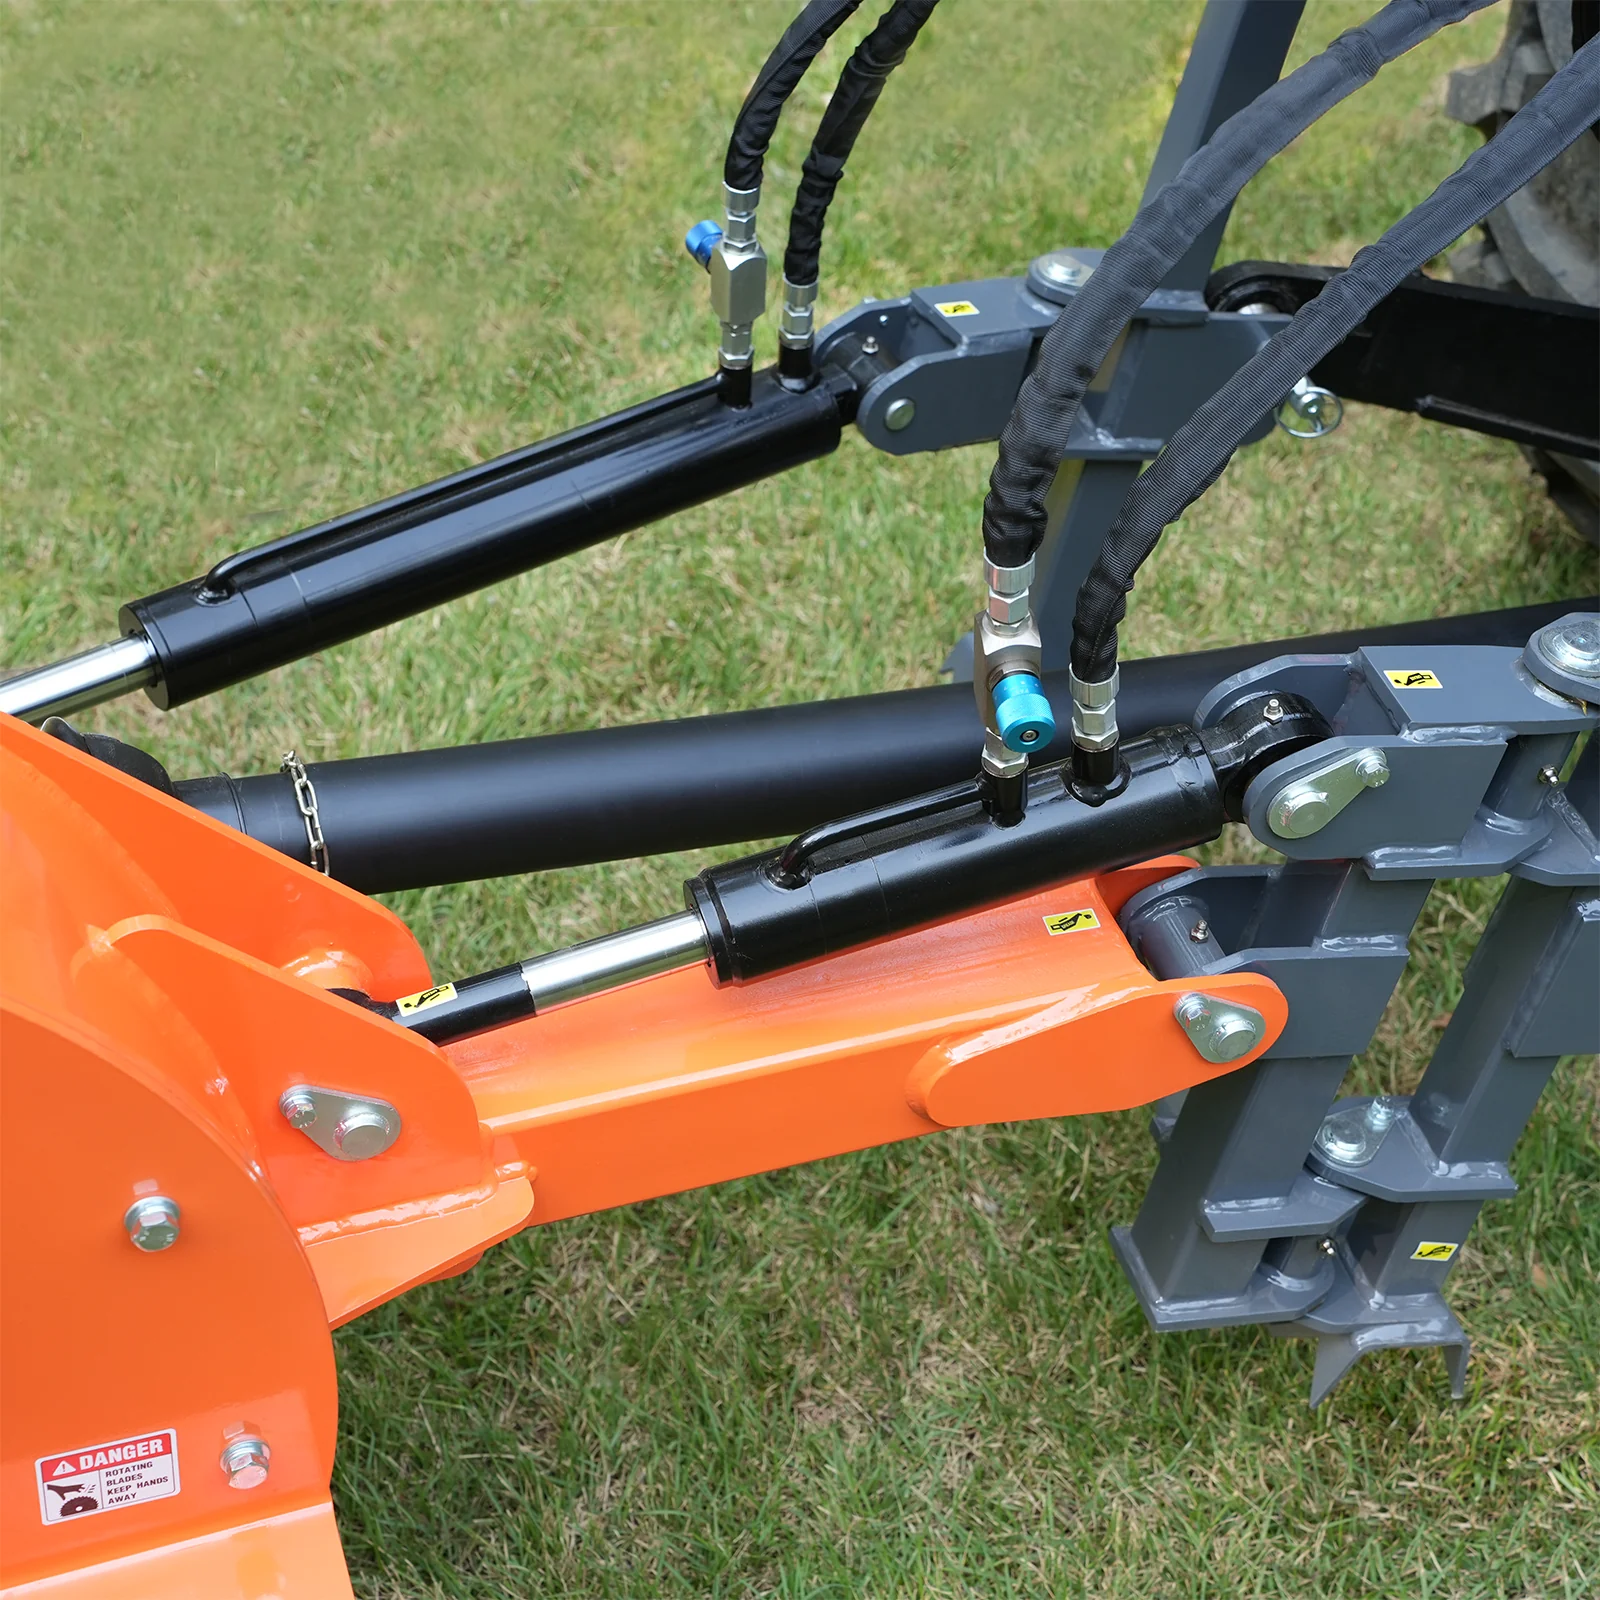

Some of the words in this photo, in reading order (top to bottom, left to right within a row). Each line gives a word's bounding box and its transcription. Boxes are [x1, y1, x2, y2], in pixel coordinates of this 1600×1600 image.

[79, 1438, 164, 1471] DANGER
[105, 1461, 153, 1478] ROTATING
[106, 1473, 143, 1487] BLADES
[107, 1484, 132, 1496] KEEP
[136, 1476, 169, 1489] HANDS
[108, 1492, 137, 1505] AWAY
